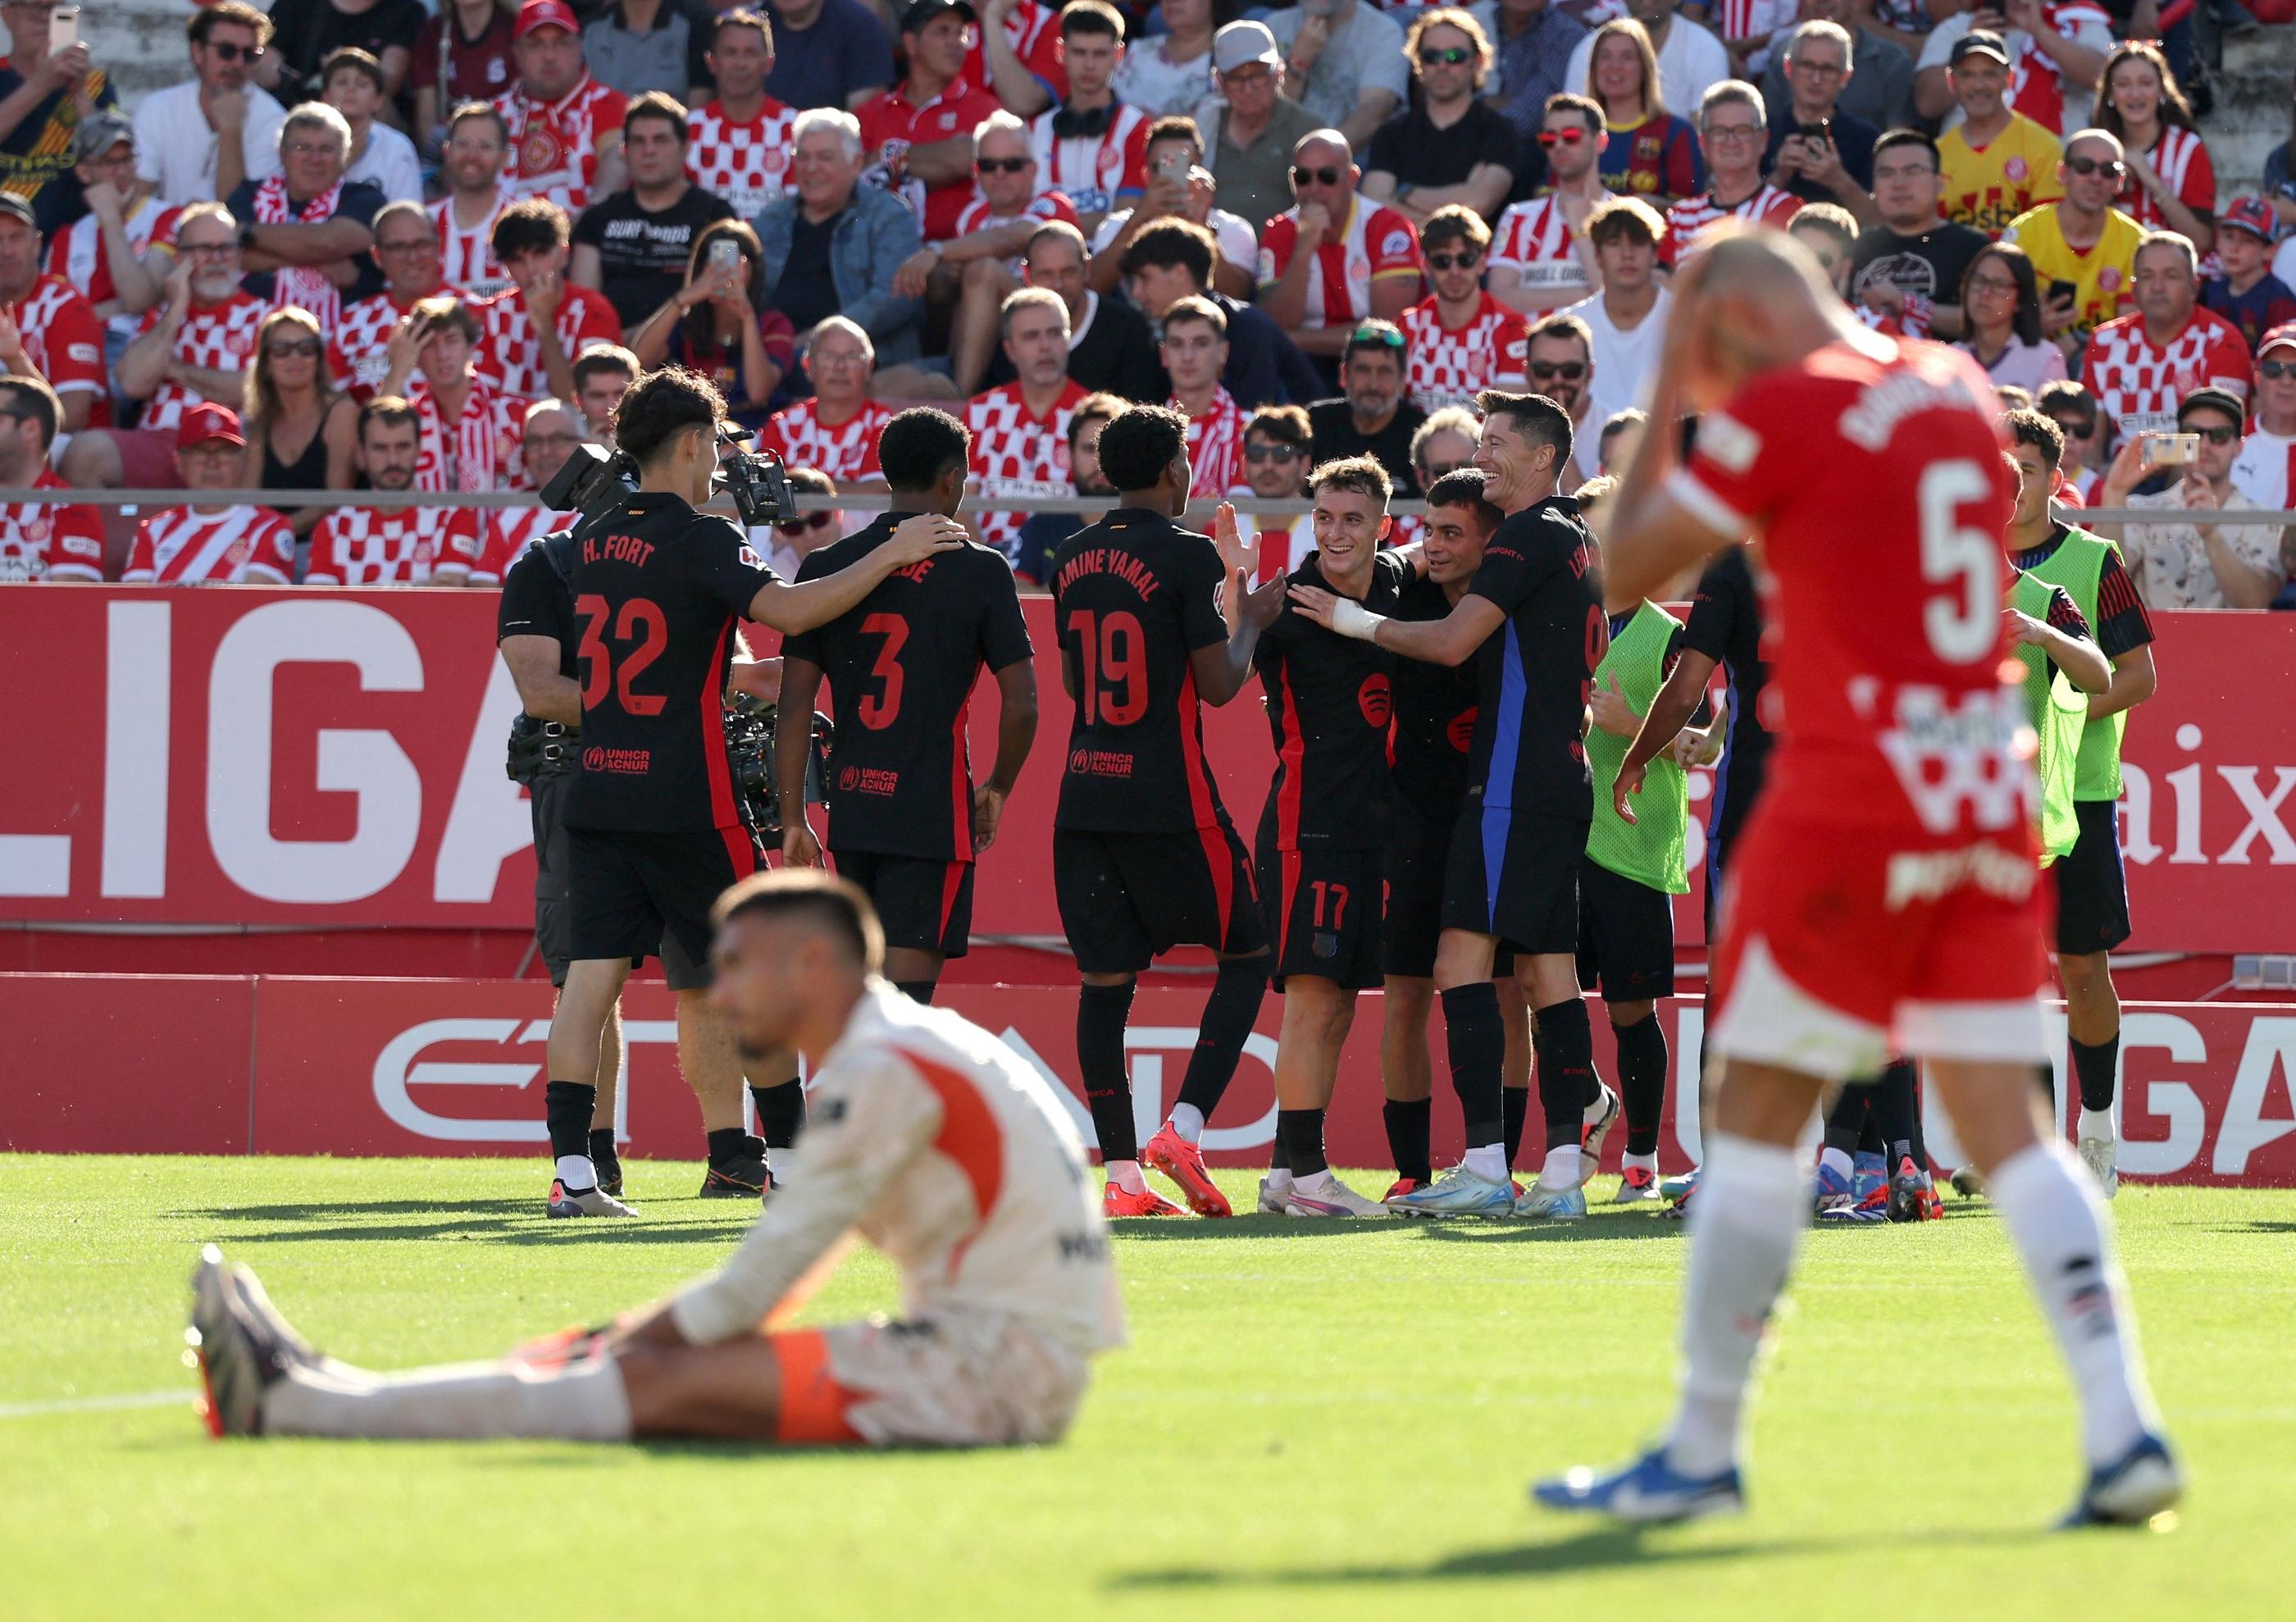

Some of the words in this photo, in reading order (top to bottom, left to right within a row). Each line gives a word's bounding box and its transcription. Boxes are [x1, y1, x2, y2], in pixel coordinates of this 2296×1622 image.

[604, 535, 654, 568] FORT
[1917, 458, 2001, 665] 5
[1108, 549, 1160, 603] YAMAL
[576, 594, 668, 716] 32
[1068, 609, 1148, 727] 19
[859, 613, 910, 731] 3
[607, 748, 650, 761] UNHCR
[607, 759, 649, 771] ACNUR
[1091, 761, 1132, 774] ACNUR
[1093, 750, 1134, 764] UNHCR
[859, 778, 896, 793] ACNUR
[862, 768, 899, 783] UNHCR
[1310, 880, 1349, 932] 17
